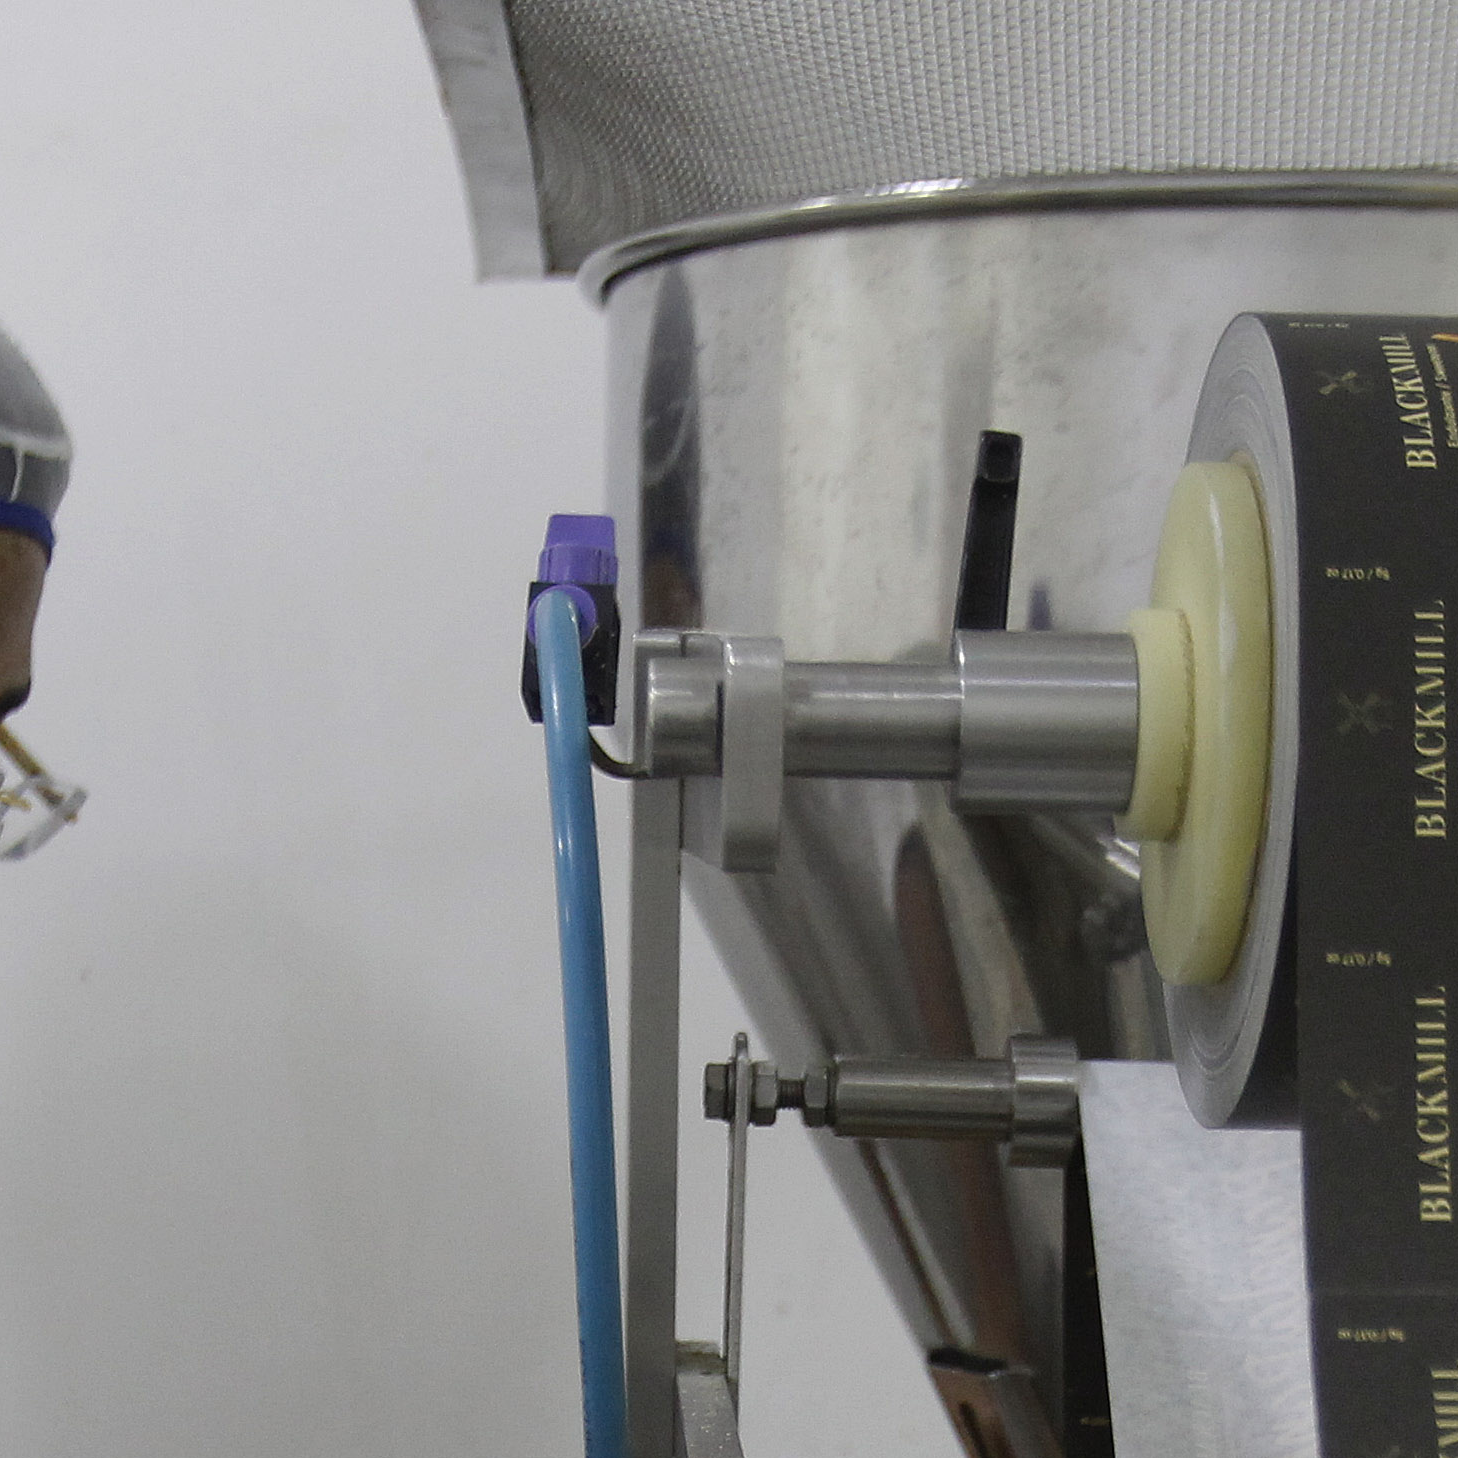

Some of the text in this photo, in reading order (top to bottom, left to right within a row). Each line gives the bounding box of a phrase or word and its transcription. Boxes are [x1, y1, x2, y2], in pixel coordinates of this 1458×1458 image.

[1378, 332, 1439, 470] BLACKMILL
[1412, 598, 1447, 838] BLACKMILL
[1414, 985, 1453, 1223] BLACKMILL
